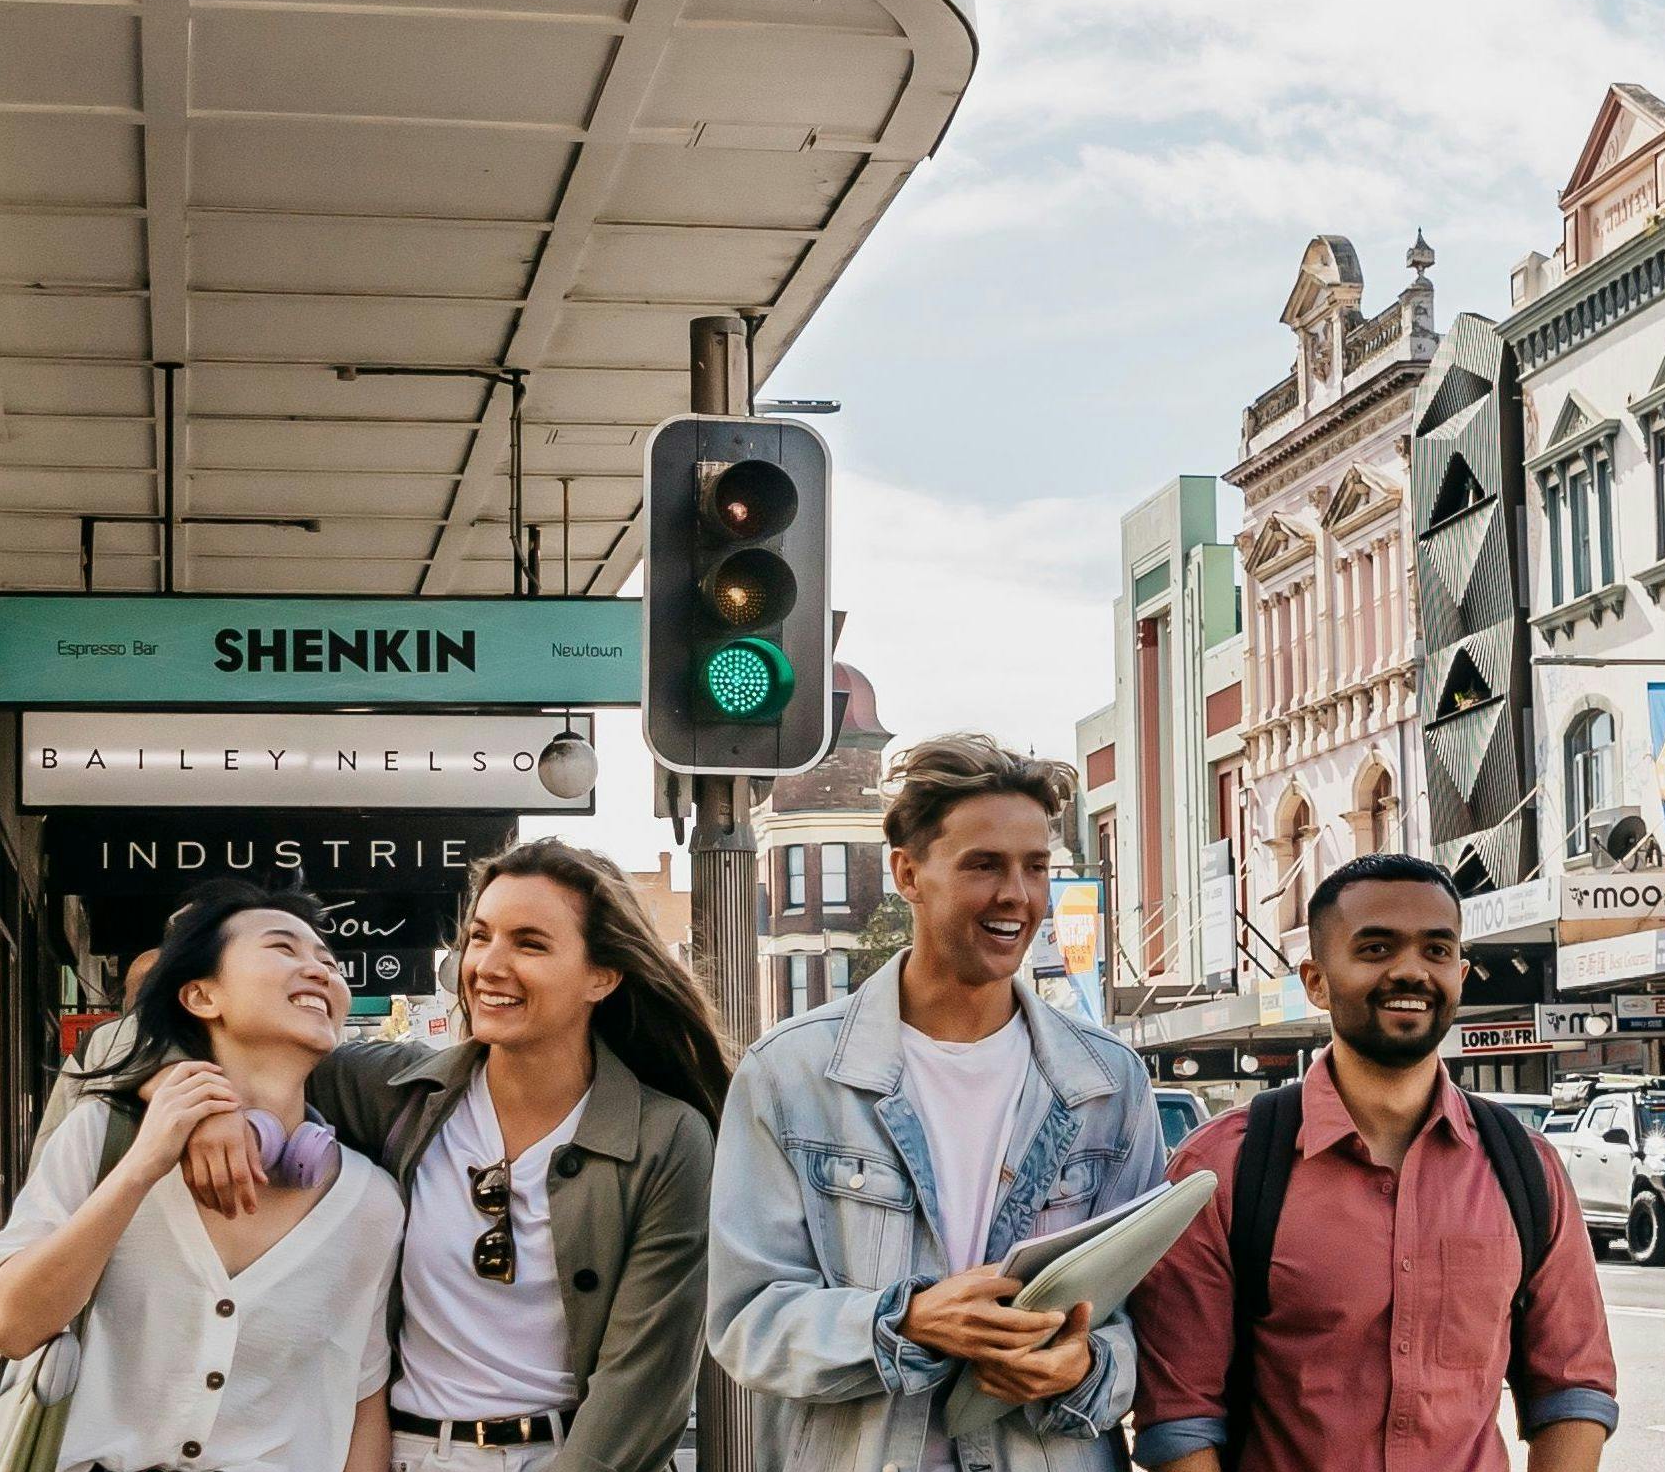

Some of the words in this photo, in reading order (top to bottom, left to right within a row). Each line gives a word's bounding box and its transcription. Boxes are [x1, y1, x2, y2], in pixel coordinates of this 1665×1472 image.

[57, 640, 127, 659] Espresso
[134, 640, 159, 656] Bar
[214, 628, 476, 673] SHENKIN
[552, 642, 624, 659] Newtown
[41, 747, 287, 772] BAILEY
[337, 750, 536, 773] NELSO
[102, 840, 468, 870] INDUSTRIE
[1593, 885, 1663, 909] moo
[1462, 1031, 1500, 1047] LORD
[1516, 1029, 1535, 1044] FRI
